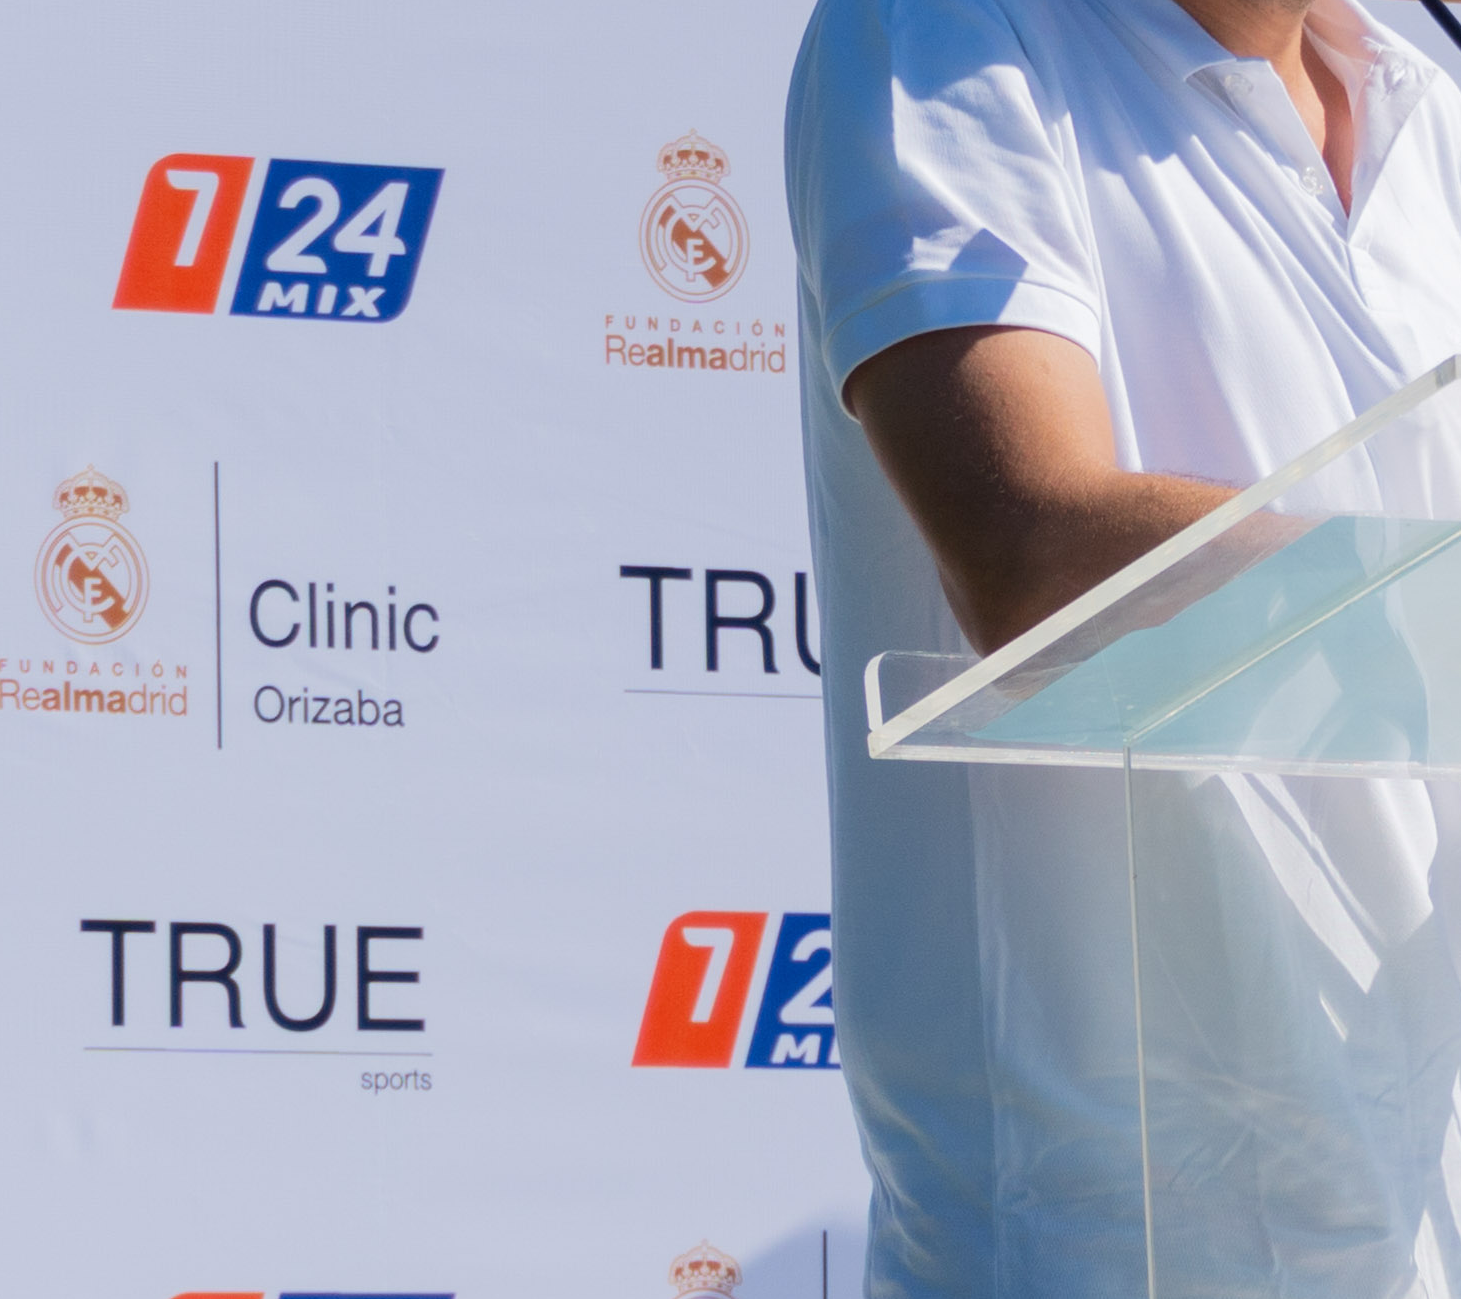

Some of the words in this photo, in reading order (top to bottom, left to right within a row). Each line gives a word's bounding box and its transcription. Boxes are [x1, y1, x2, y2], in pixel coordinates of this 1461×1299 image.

[265, 177, 409, 277] 24
[255, 282, 386, 319] MIX
[605, 315, 785, 337] FUNDACIÓN
[606, 335, 785, 373] Realmadrid
[250, 579, 438, 653] Clinic
[0, 679, 187, 715] Realmadrid
[254, 685, 404, 726] Orizaba
[81, 920, 424, 1032] TRUE
[361, 1070, 432, 1095] sports
